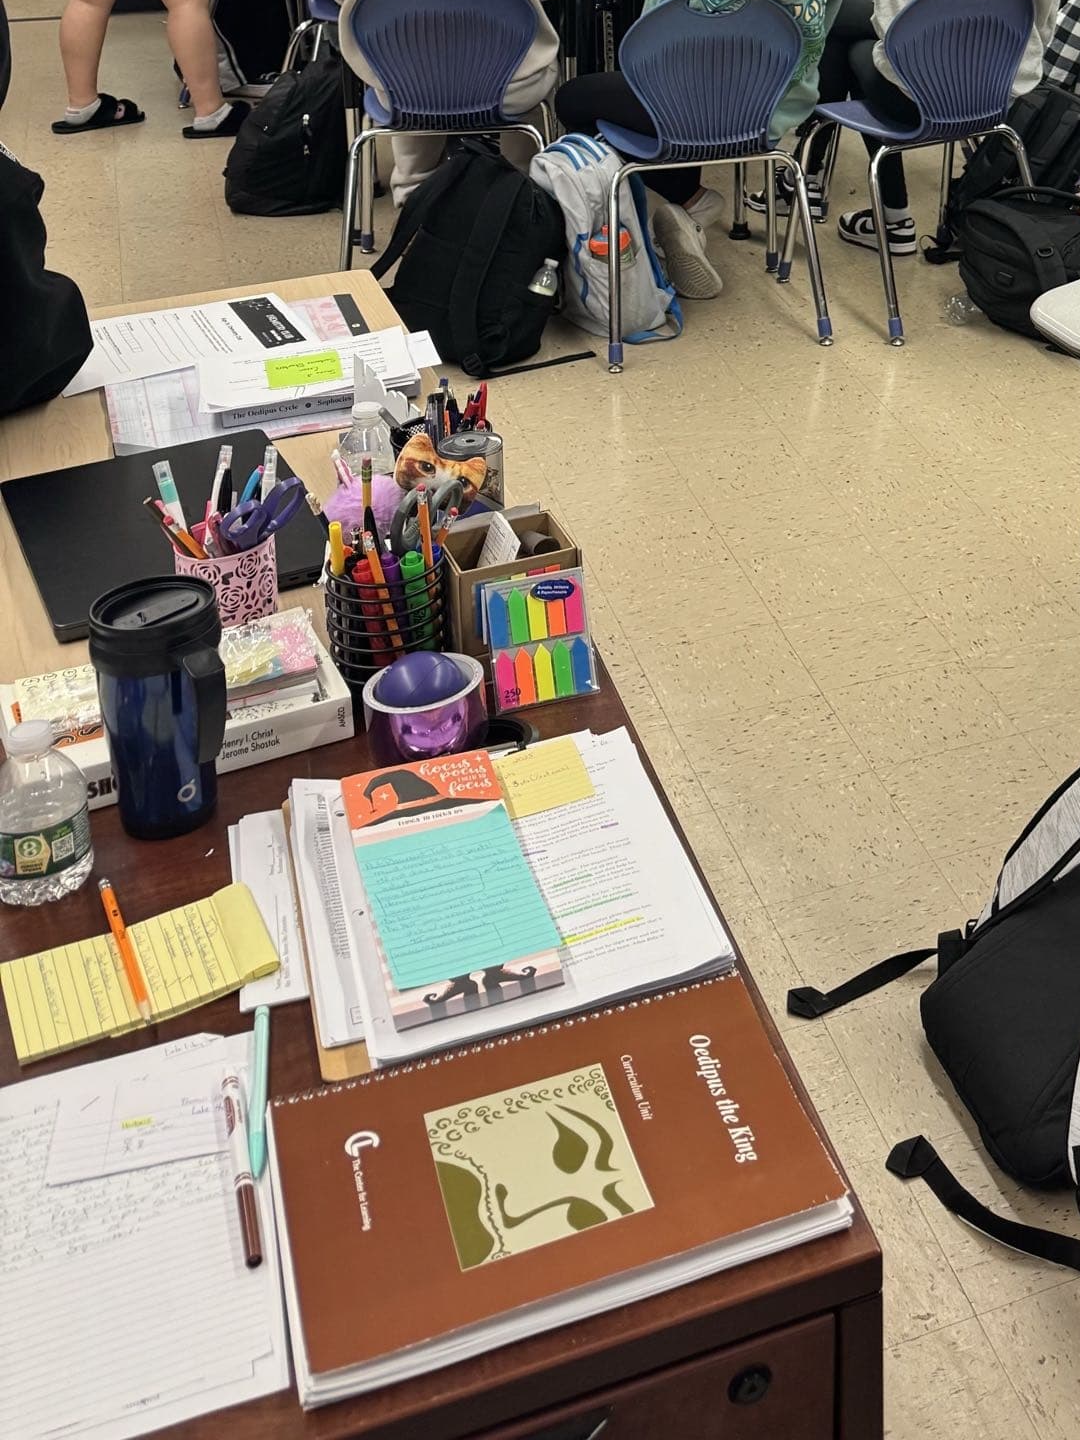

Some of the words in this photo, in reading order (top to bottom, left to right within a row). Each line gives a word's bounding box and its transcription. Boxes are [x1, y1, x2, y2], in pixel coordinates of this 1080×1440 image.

[232, 411, 247, 421] The
[247, 405, 277, 419] Oedipus
[278, 403, 298, 415] Cycle
[504, 688, 521, 698] 250
[221, 736, 246, 749] Henry
[252, 729, 274, 741] Christ
[222, 746, 249, 760] Jerome
[250, 736, 280, 752] Shostak
[420, 759, 470, 775] hocus
[440, 765, 487, 782] pocus
[448, 779, 492, 797] focus
[620, 1054, 644, 1101] Curriculum
[637, 1101, 653, 1121] Unit
[689, 1034, 727, 1097] Oedipus
[715, 1098, 740, 1124] the
[728, 1125, 758, 1163] King
[352, 1158, 361, 1172] The
[354, 1171, 364, 1192] Center
[358, 1191, 367, 1202] for
[360, 1201, 372, 1232] Learning
